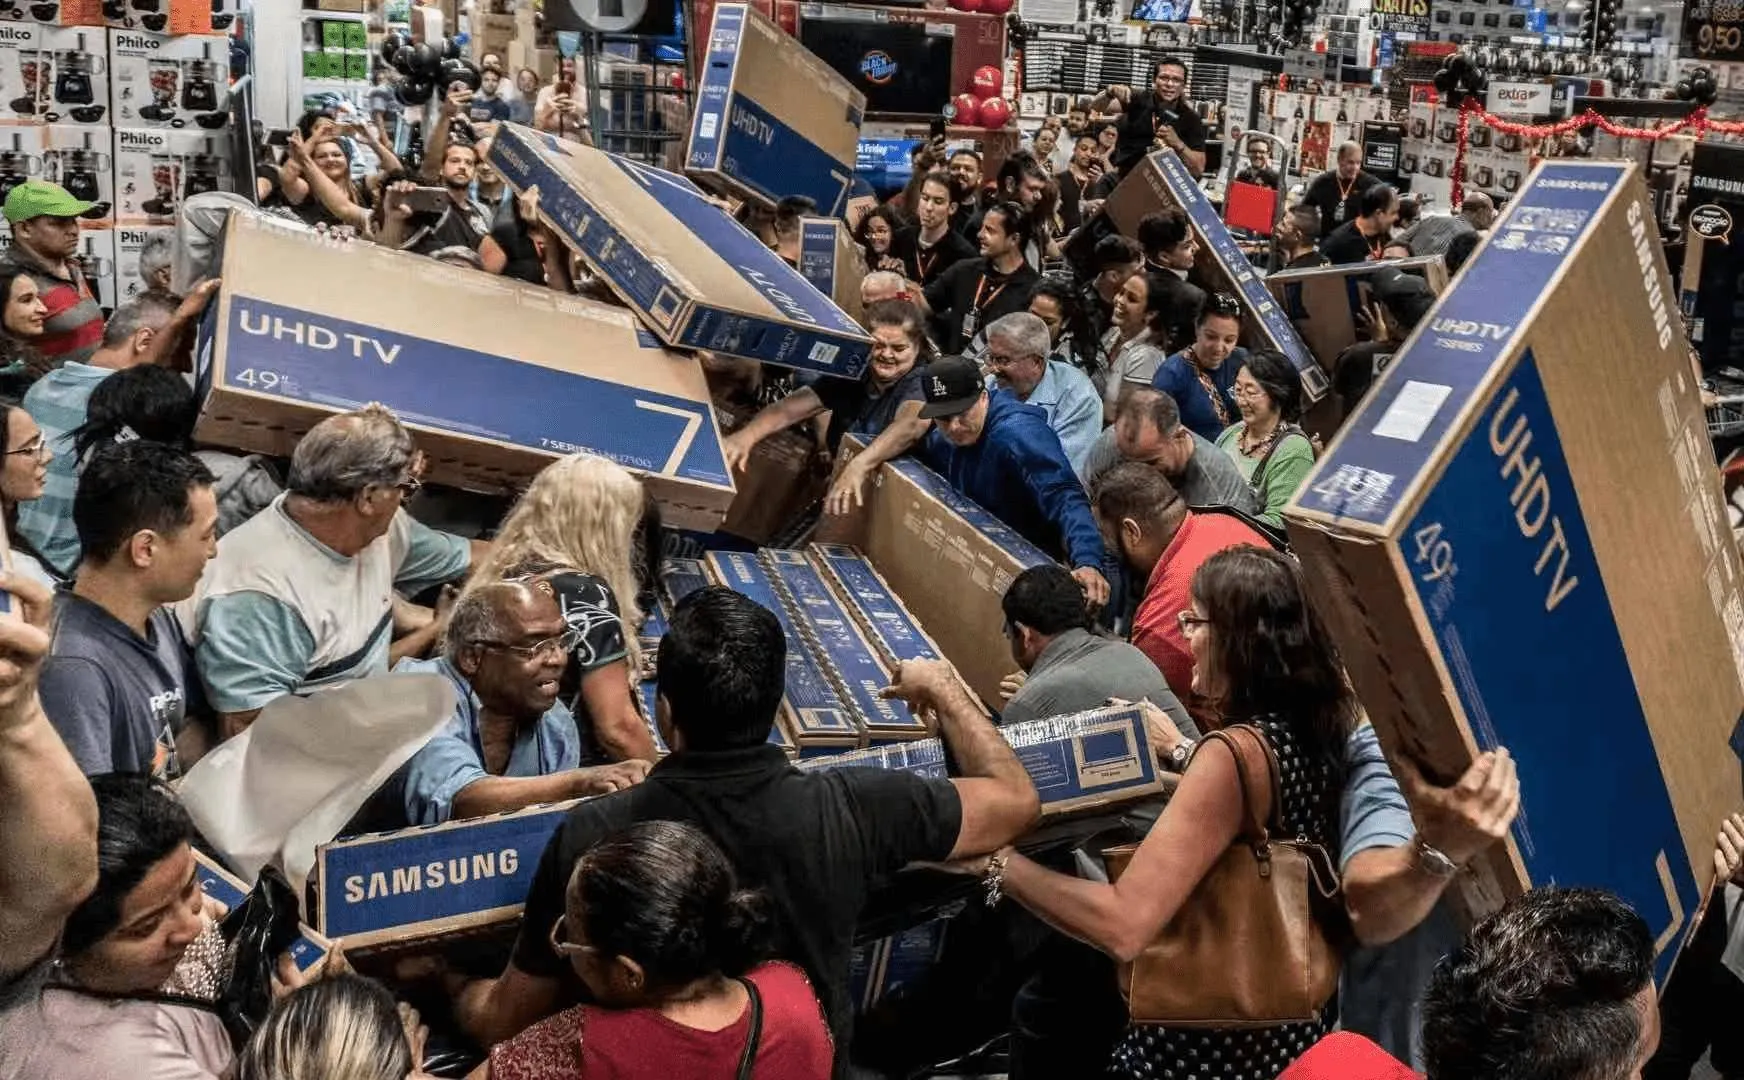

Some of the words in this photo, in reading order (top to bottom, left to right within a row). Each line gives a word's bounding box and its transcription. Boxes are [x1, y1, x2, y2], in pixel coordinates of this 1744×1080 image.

[116, 35, 161, 49] Philco
[1498, 88, 1529, 101] extra
[120, 131, 163, 145] Philco
[1161, 156, 1197, 203] SAMSUNG
[1536, 178, 1609, 190] SAMSUNG
[1627, 200, 1673, 350] SAMSUNG
[240, 309, 338, 350] UHD
[344, 333, 402, 364] TV
[1431, 318, 1479, 336] UHD
[1479, 322, 1511, 339] TV
[235, 367, 289, 389] 49"
[634, 399, 704, 476] 7
[1489, 387, 1550, 538] UHD
[1533, 515, 1579, 611] TV
[345, 848, 519, 903] SAMSUNG
